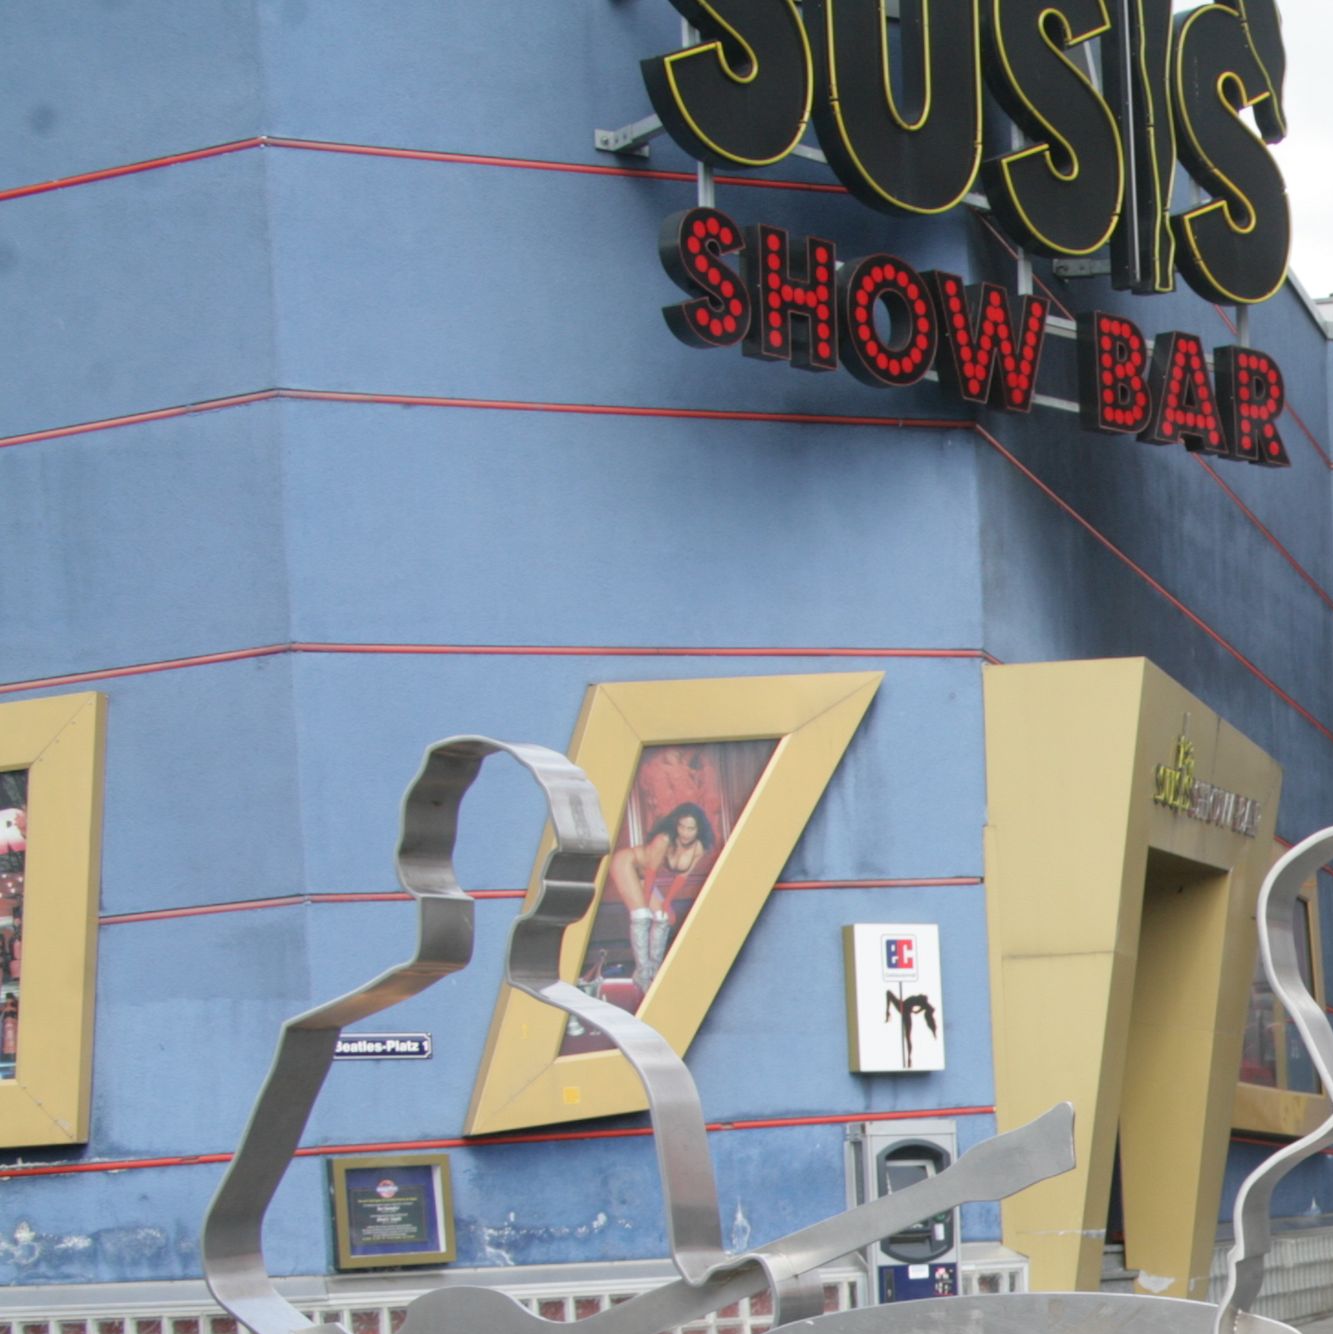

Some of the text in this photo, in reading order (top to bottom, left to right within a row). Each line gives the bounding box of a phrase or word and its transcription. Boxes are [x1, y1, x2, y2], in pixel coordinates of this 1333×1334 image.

[660, 207, 1291, 468] SHOW BAR
[335, 1039, 429, 1053] Beatles-Platz 1
